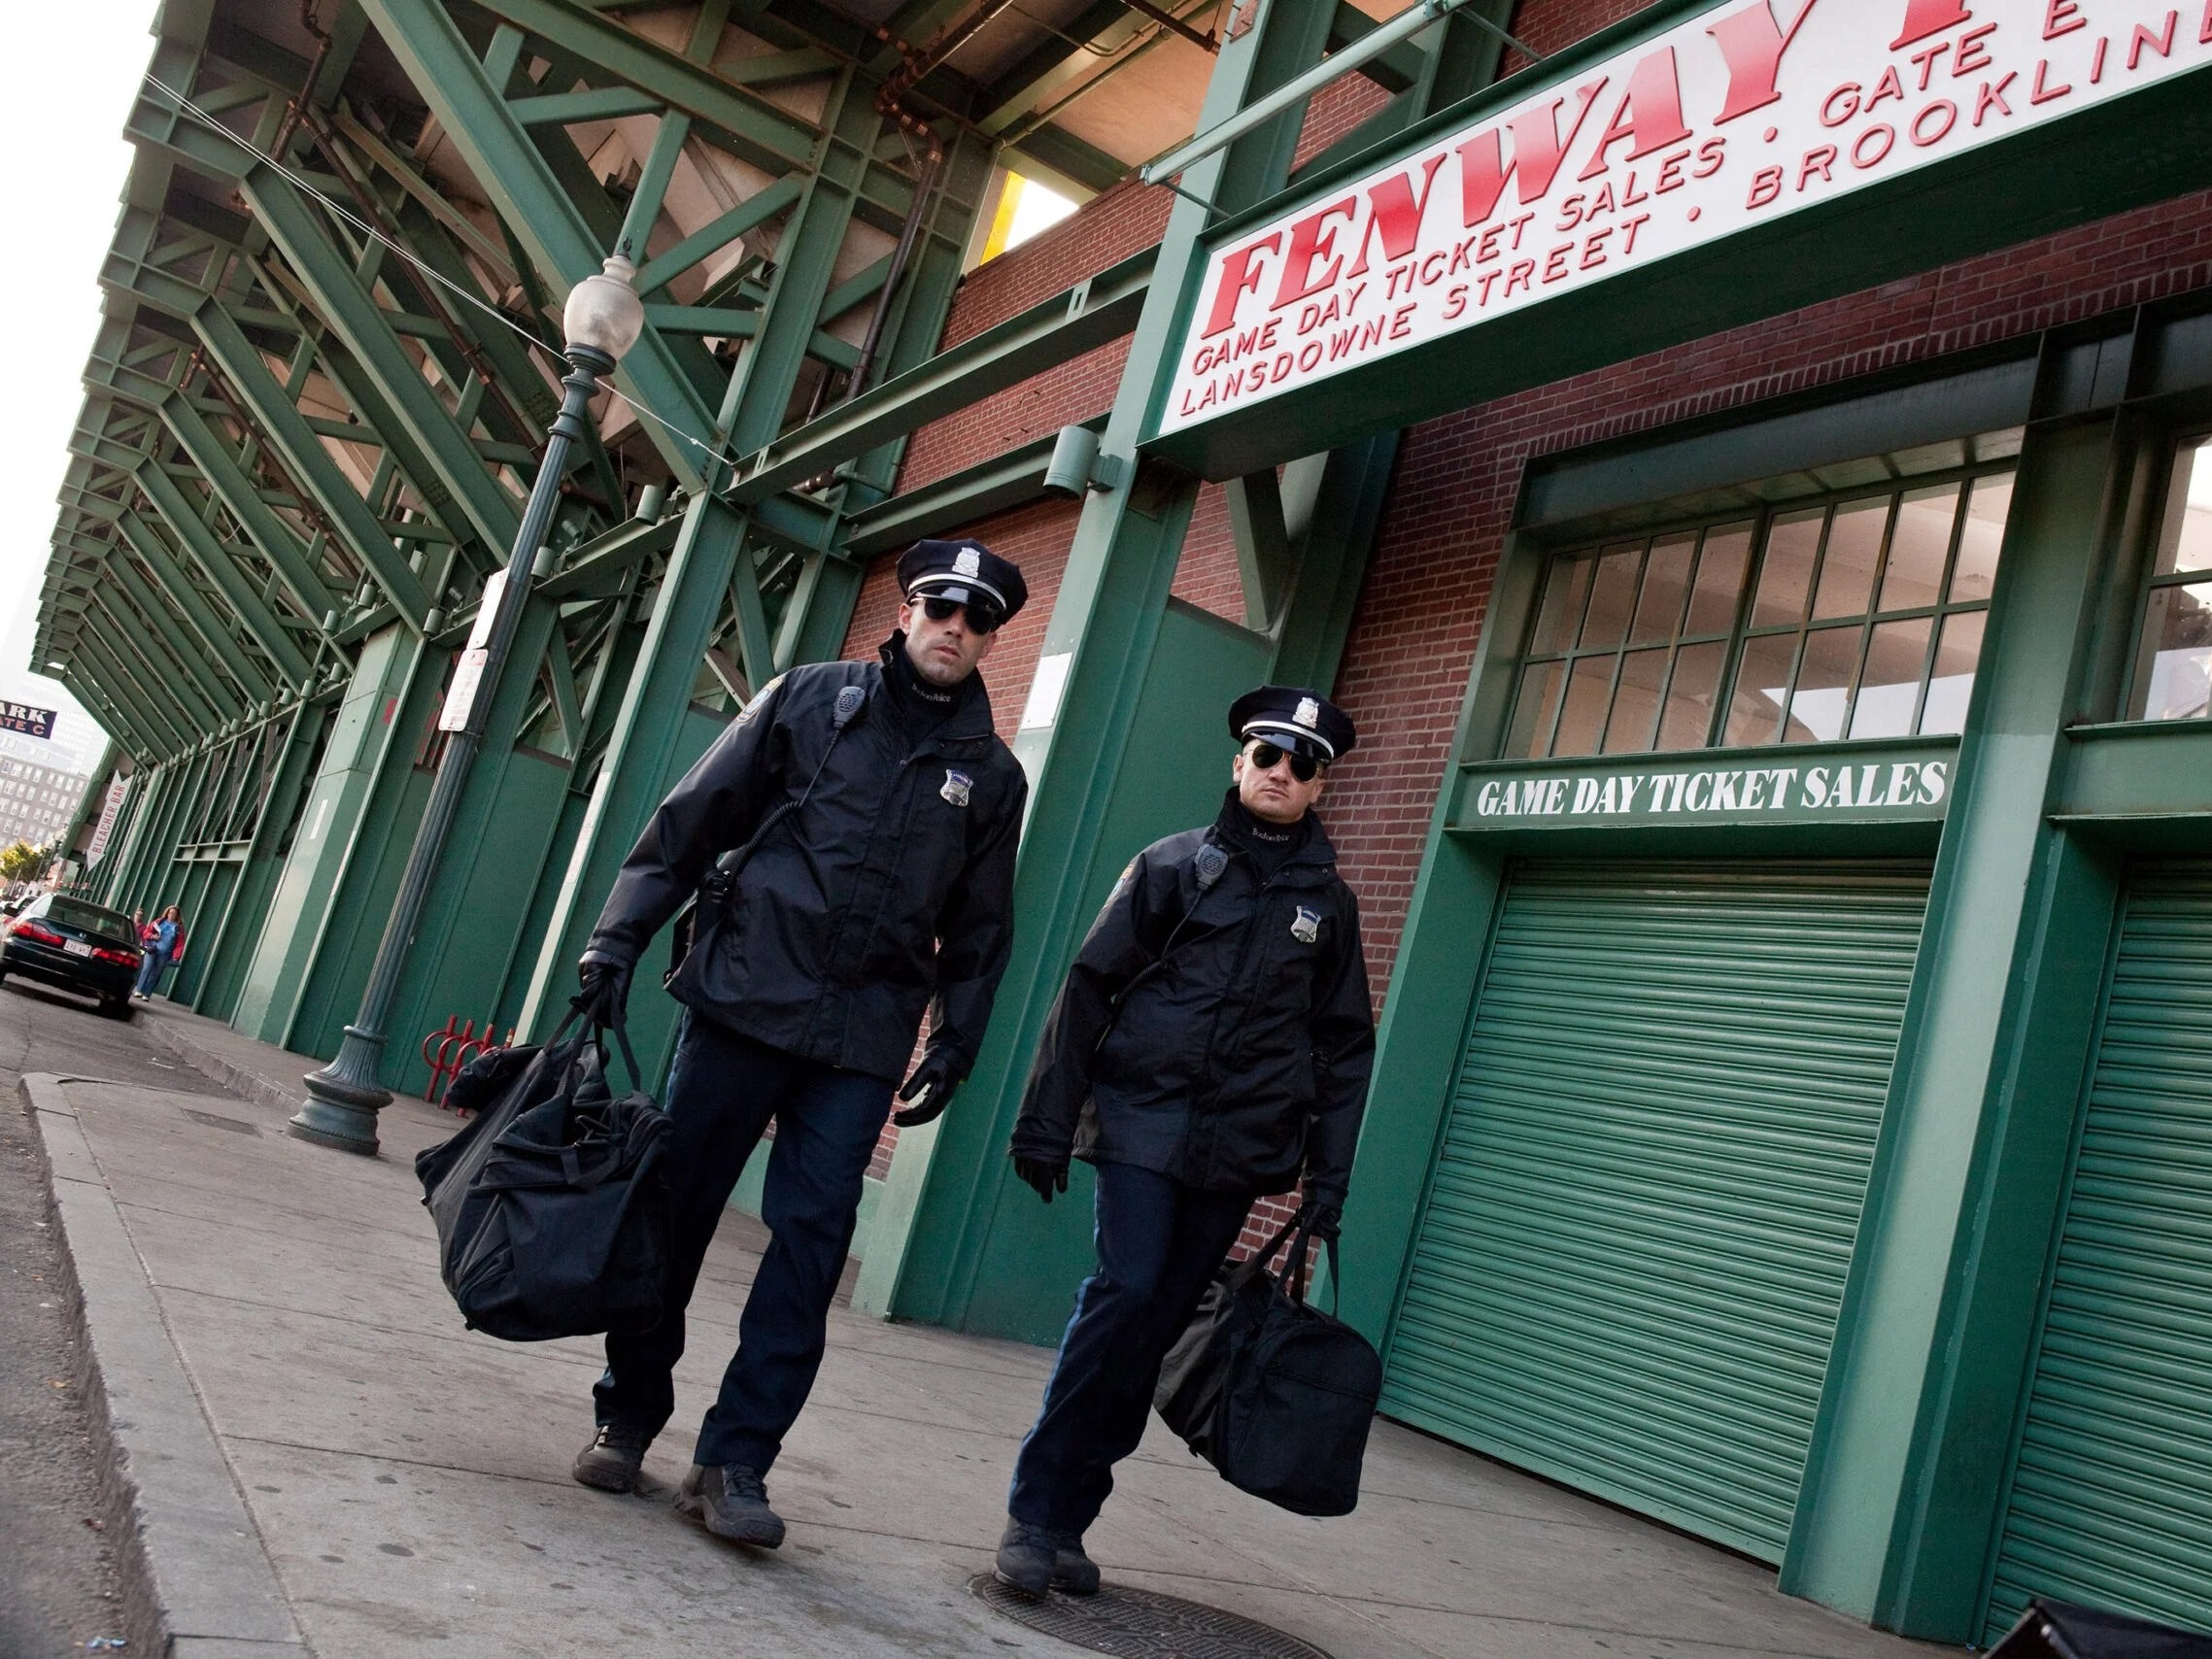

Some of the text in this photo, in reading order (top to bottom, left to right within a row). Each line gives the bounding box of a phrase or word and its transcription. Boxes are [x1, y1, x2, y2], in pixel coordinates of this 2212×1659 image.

[1192, 318, 1283, 377] GAME
[1298, 282, 1367, 335] DAY
[1385, 212, 1535, 300] TICKET
[1554, 136, 1726, 231] SALES
[1819, 21, 1997, 127] GATE
[2042, 0, 2088, 41] E
[1200, 0, 1817, 340] FENWAY
[1180, 302, 1417, 417] LANSDOWNE
[1442, 214, 1650, 320] STREET
[92, 785, 125, 854] BLEACHER BAR
[1477, 761, 1948, 817] GAME DAY TICKET SALES
